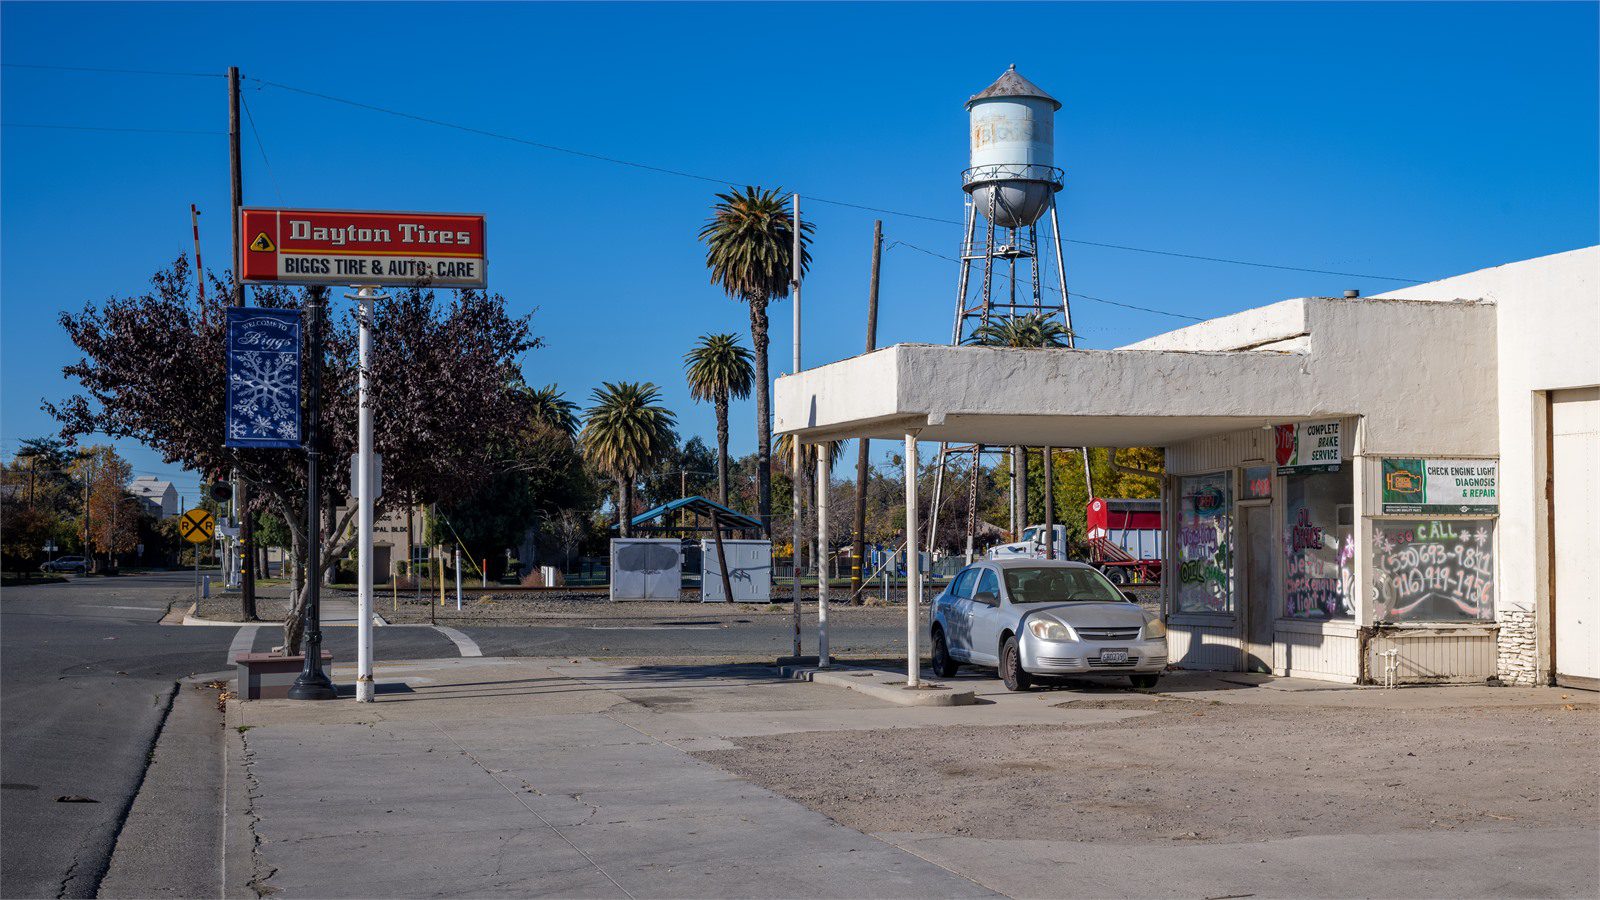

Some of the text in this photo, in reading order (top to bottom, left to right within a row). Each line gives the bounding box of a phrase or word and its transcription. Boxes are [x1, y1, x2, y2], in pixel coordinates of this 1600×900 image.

[289, 220, 471, 246] Dayton Tires
[285, 257, 474, 277] BIGGS TIRE & AUTO CARE
[242, 320, 288, 331] WELCOME TO
[237, 330, 292, 350] Biggs
[1307, 423, 1339, 436] COMPLETE
[1318, 436, 1339, 448] BRAKE
[1311, 449, 1338, 461] SERVICE
[1427, 467, 1496, 476] CHECK ENGINE LIGHT
[1455, 478, 1496, 487] DIAGNOSIS
[1462, 489, 1496, 498] & REPAIR
[181, 521, 212, 530] R R
[1417, 523, 1457, 539] CALL
[1181, 561, 1204, 583] OIL
